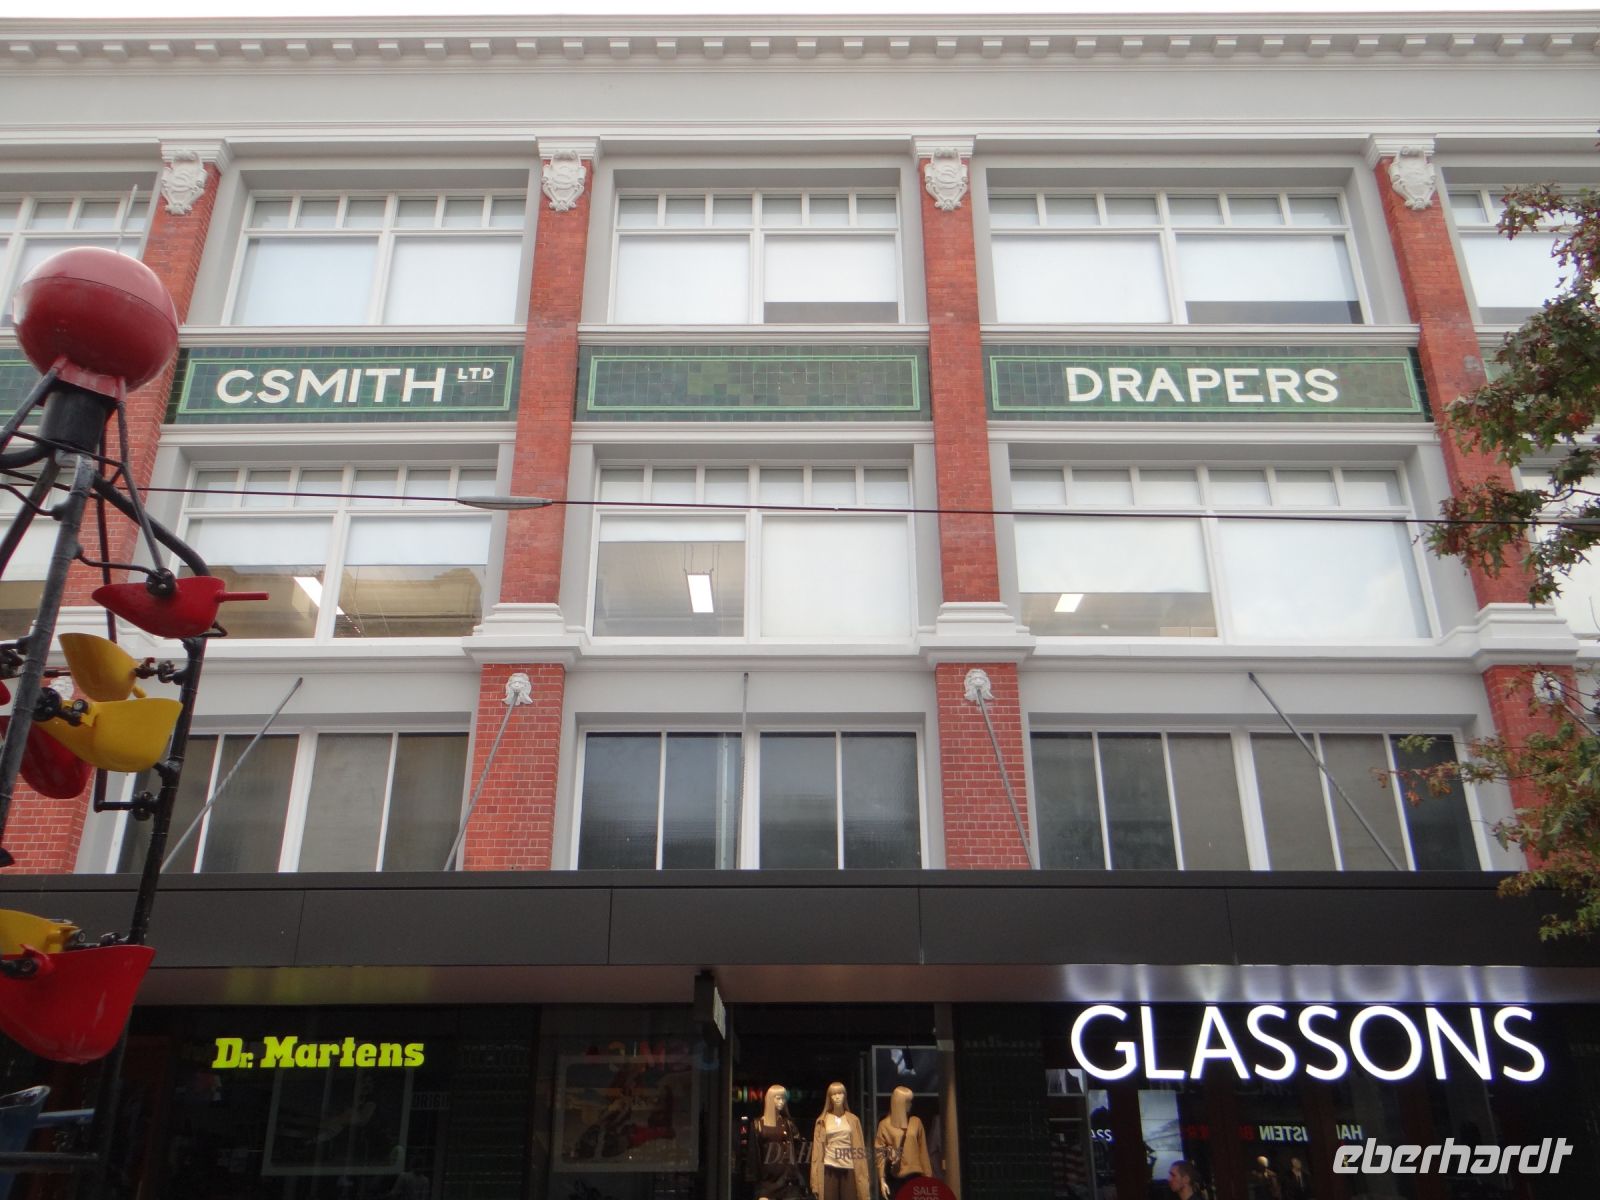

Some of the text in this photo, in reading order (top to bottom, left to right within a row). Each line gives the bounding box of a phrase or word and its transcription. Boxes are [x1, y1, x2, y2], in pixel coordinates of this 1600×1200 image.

[457, 366, 495, 381] LTD
[1065, 366, 1339, 403] DRAPERS
[211, 1035, 425, 1069] Dr. Martens
[1070, 1004, 1546, 1083] GLASSONS
[912, 1185, 939, 1196] SALE
